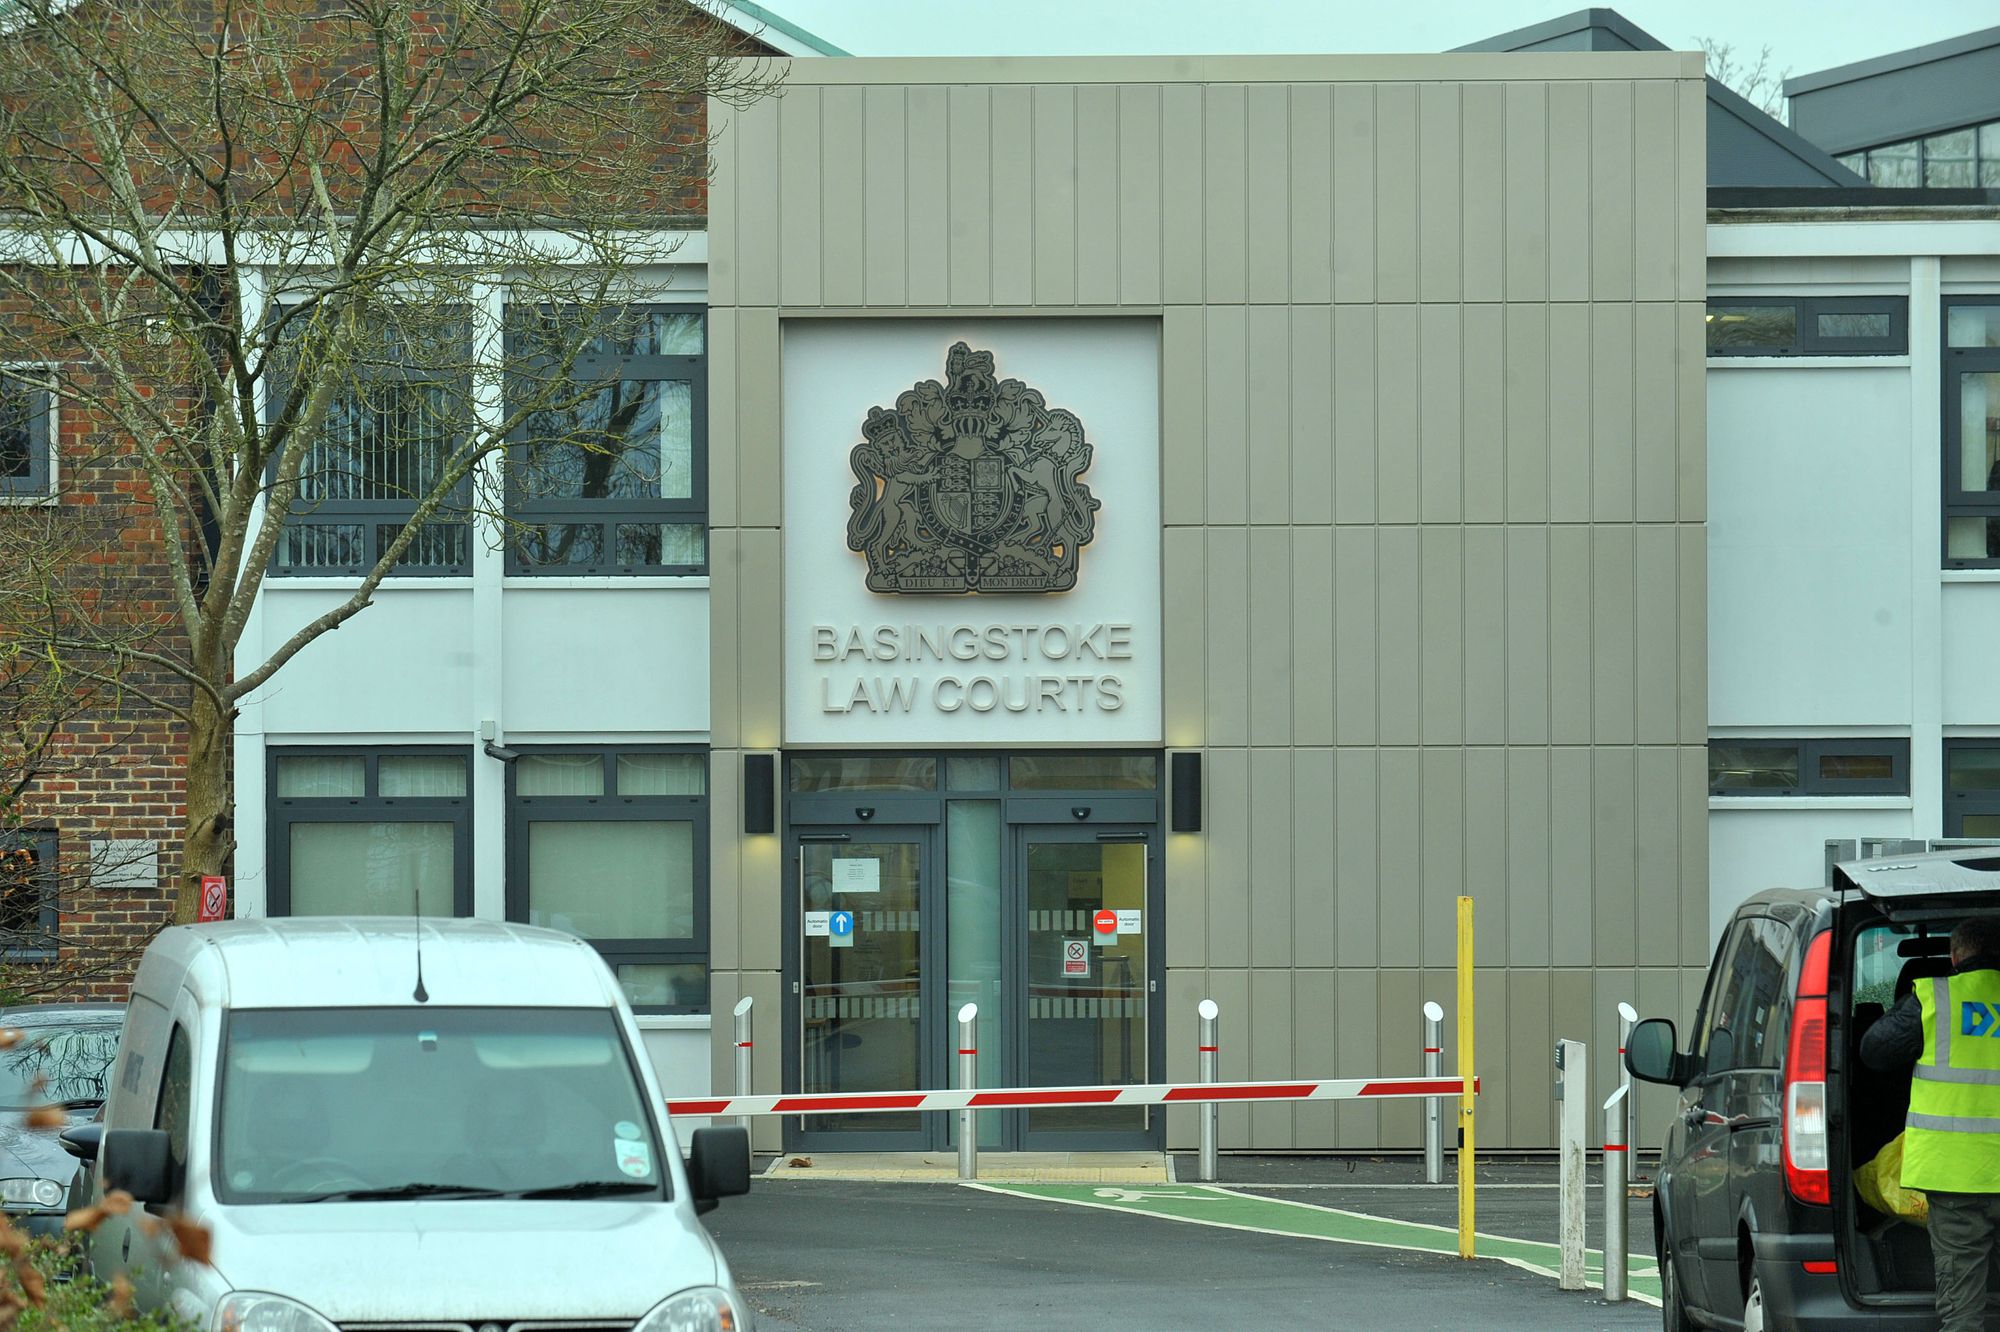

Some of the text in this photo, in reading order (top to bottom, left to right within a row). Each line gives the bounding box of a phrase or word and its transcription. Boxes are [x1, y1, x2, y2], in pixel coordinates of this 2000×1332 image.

[905, 578, 958, 587] DIEU ET
[983, 578, 1046, 587] MON DROIT
[812, 623, 1132, 662] BASINGSTOKE
[822, 674, 1124, 713] LAW COURTS
